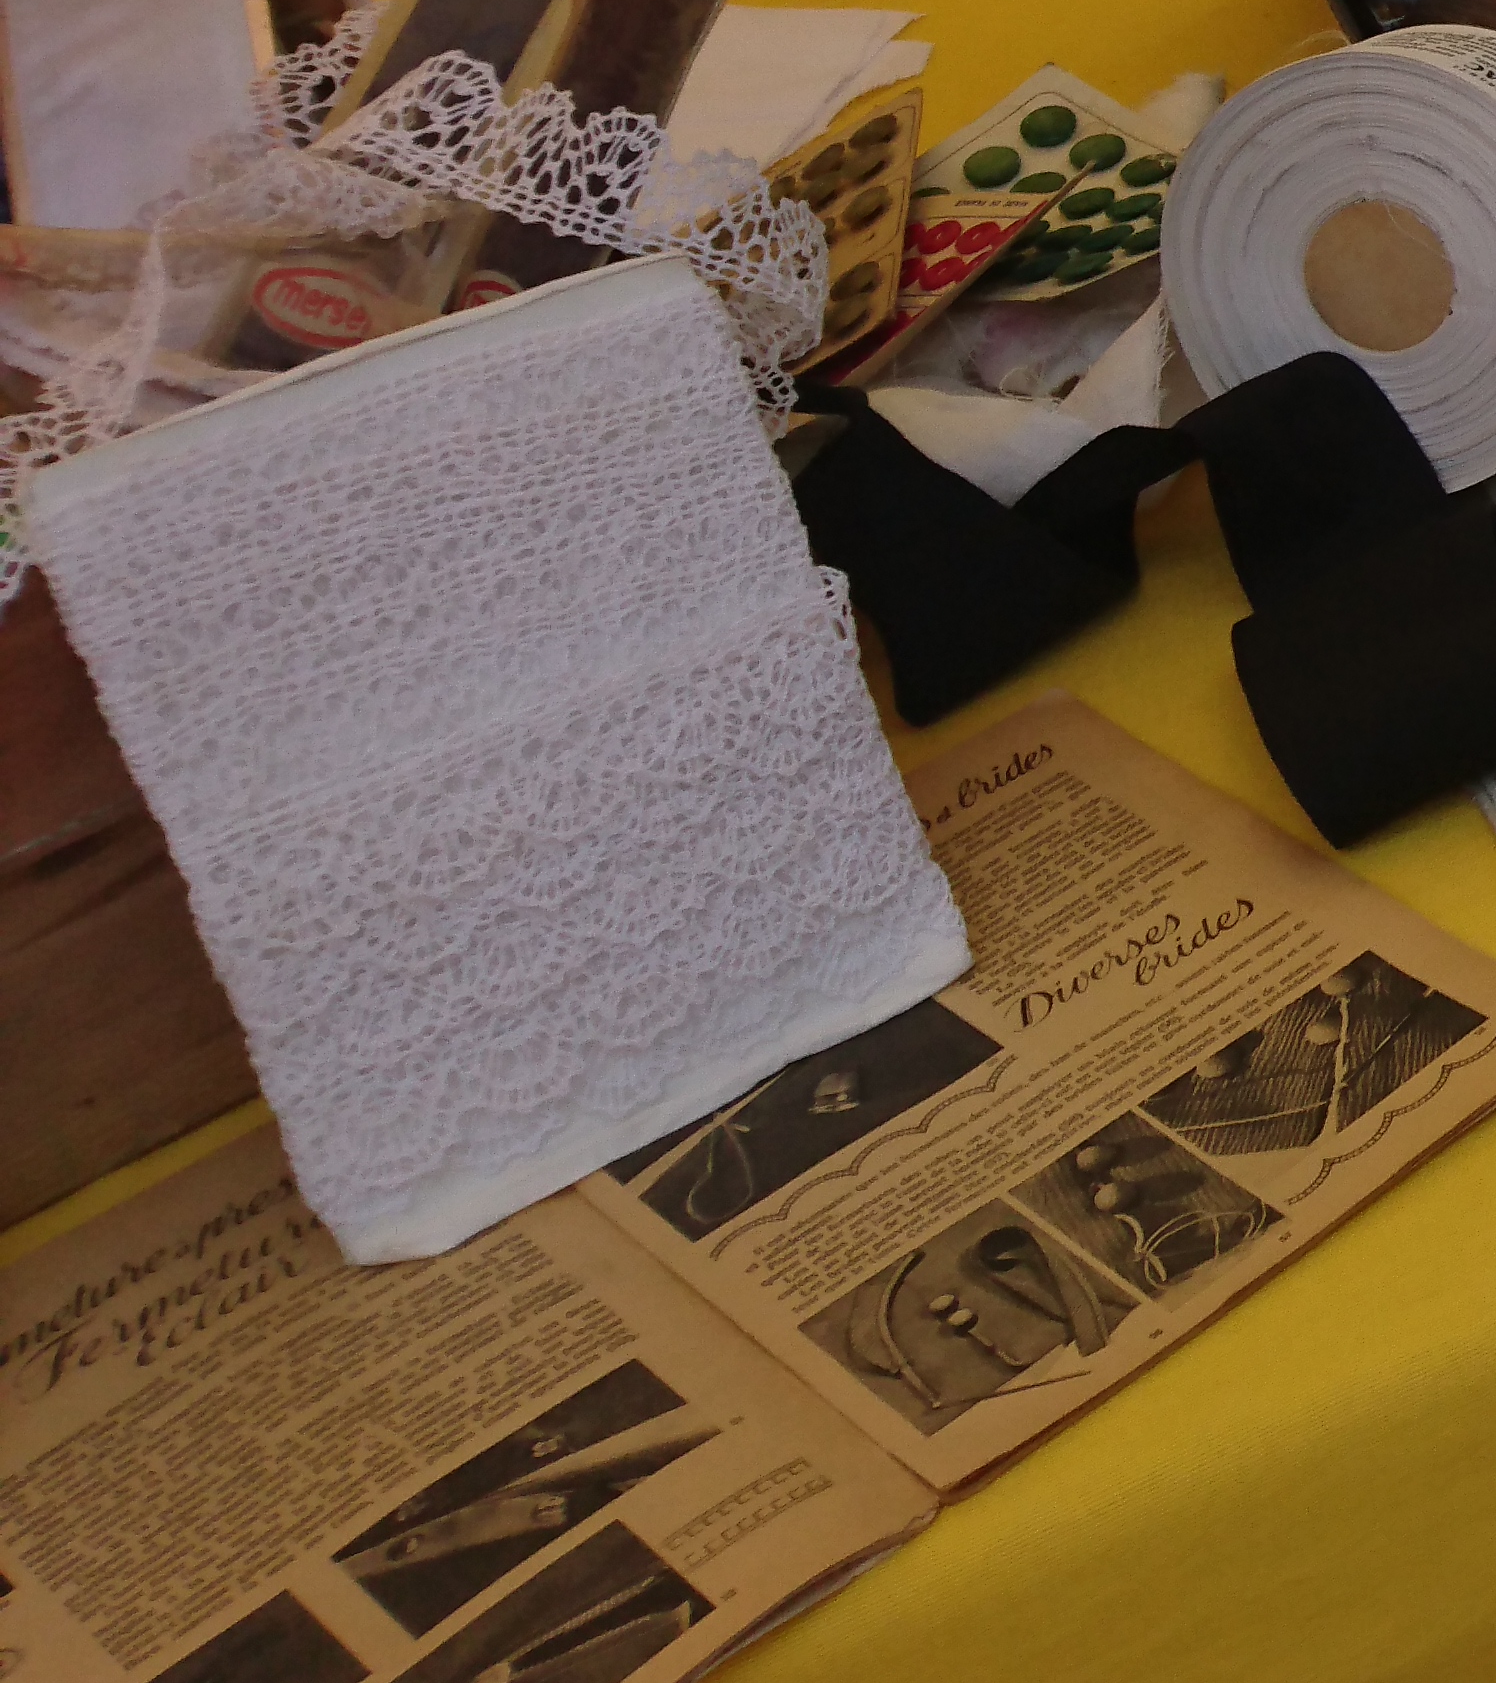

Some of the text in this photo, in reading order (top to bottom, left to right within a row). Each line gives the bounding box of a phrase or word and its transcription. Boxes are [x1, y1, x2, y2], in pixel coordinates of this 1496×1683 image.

[954, 742, 1054, 810] brides
[1003, 912, 1184, 1032] Diverses
[1133, 896, 1255, 987] brides
